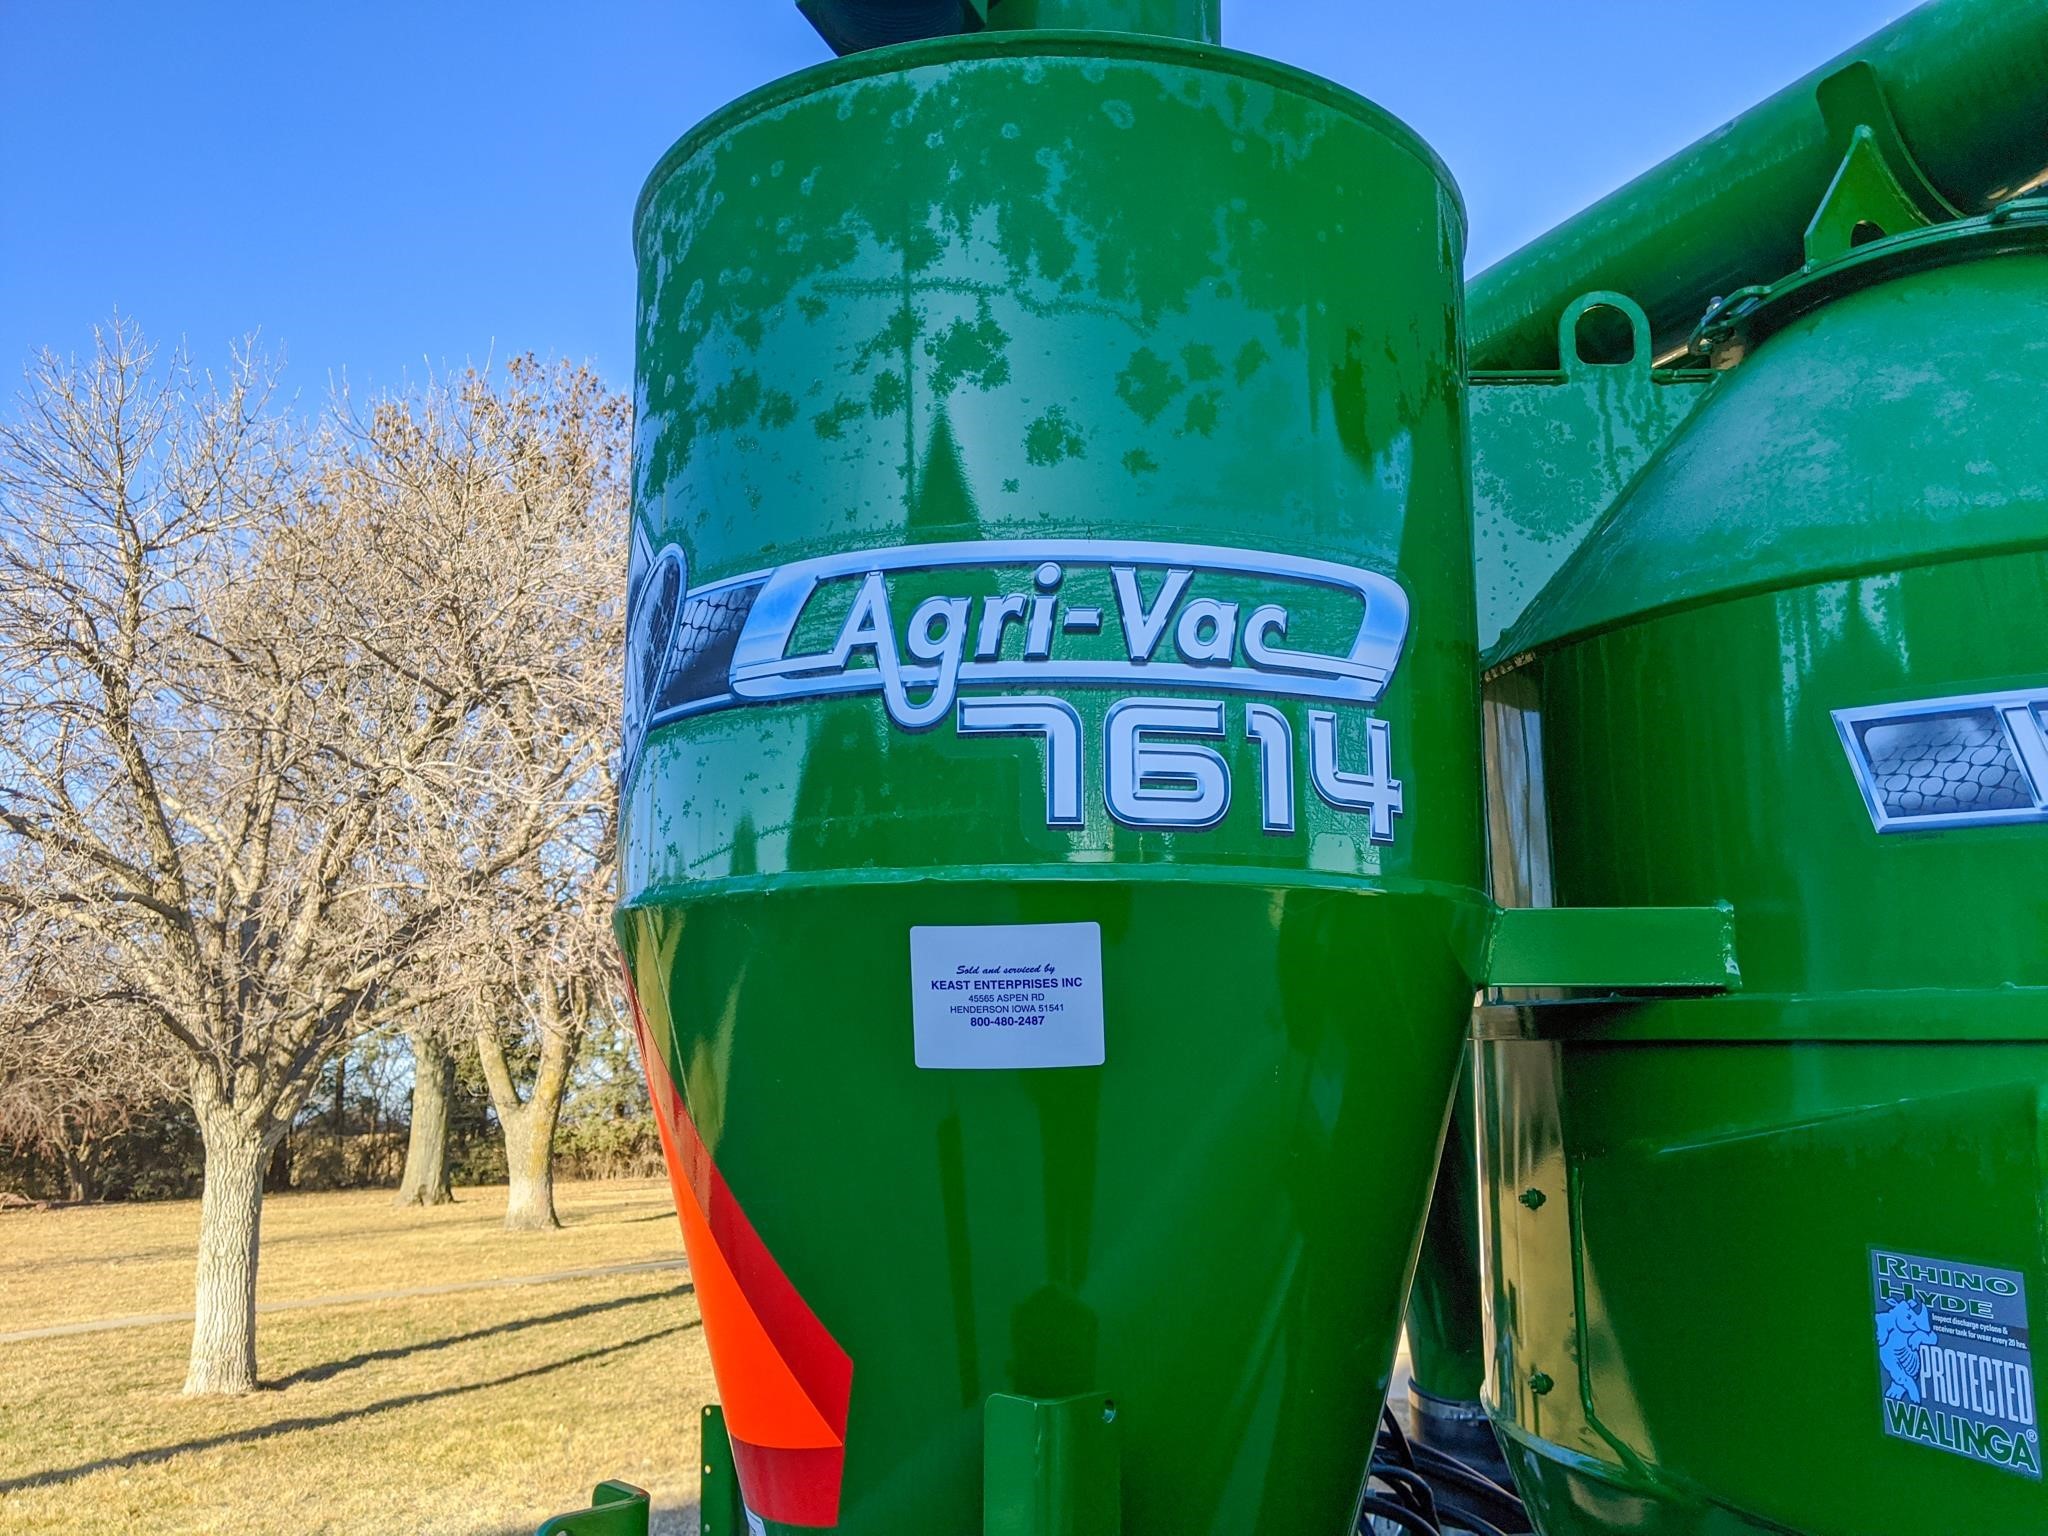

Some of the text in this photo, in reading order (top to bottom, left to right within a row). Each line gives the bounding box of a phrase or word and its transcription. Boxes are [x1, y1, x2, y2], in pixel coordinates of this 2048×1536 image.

[824, 562, 1296, 730] Agri-Vac
[957, 696, 1403, 844] 7614
[956, 963, 1056, 976] Sold and serviced by
[931, 977, 1083, 991] KEAST ENTERPRISES INC
[950, 1003, 1065, 1014] HENDERSON IOWA 51541
[997, 994, 1029, 1002] ASPEN
[1031, 993, 1045, 1002] RD
[970, 1015, 1046, 1027] 800-480-2487
[1876, 1253, 2018, 1297] RHINO
[1879, 1277, 1994, 1319] HYDE
[1932, 1313, 2009, 1335] Inspect discharge cyclone &
[1932, 1325, 1955, 1334] receiver
[1955, 1328, 1968, 1337] tank
[1977, 1334, 1992, 1342] wear
[1992, 1337, 2008, 1347] every
[2008, 1338, 2016, 1347] 20
[2016, 1340, 2028, 1350] hrs.
[1920, 1344, 2035, 1426] PROTECTED
